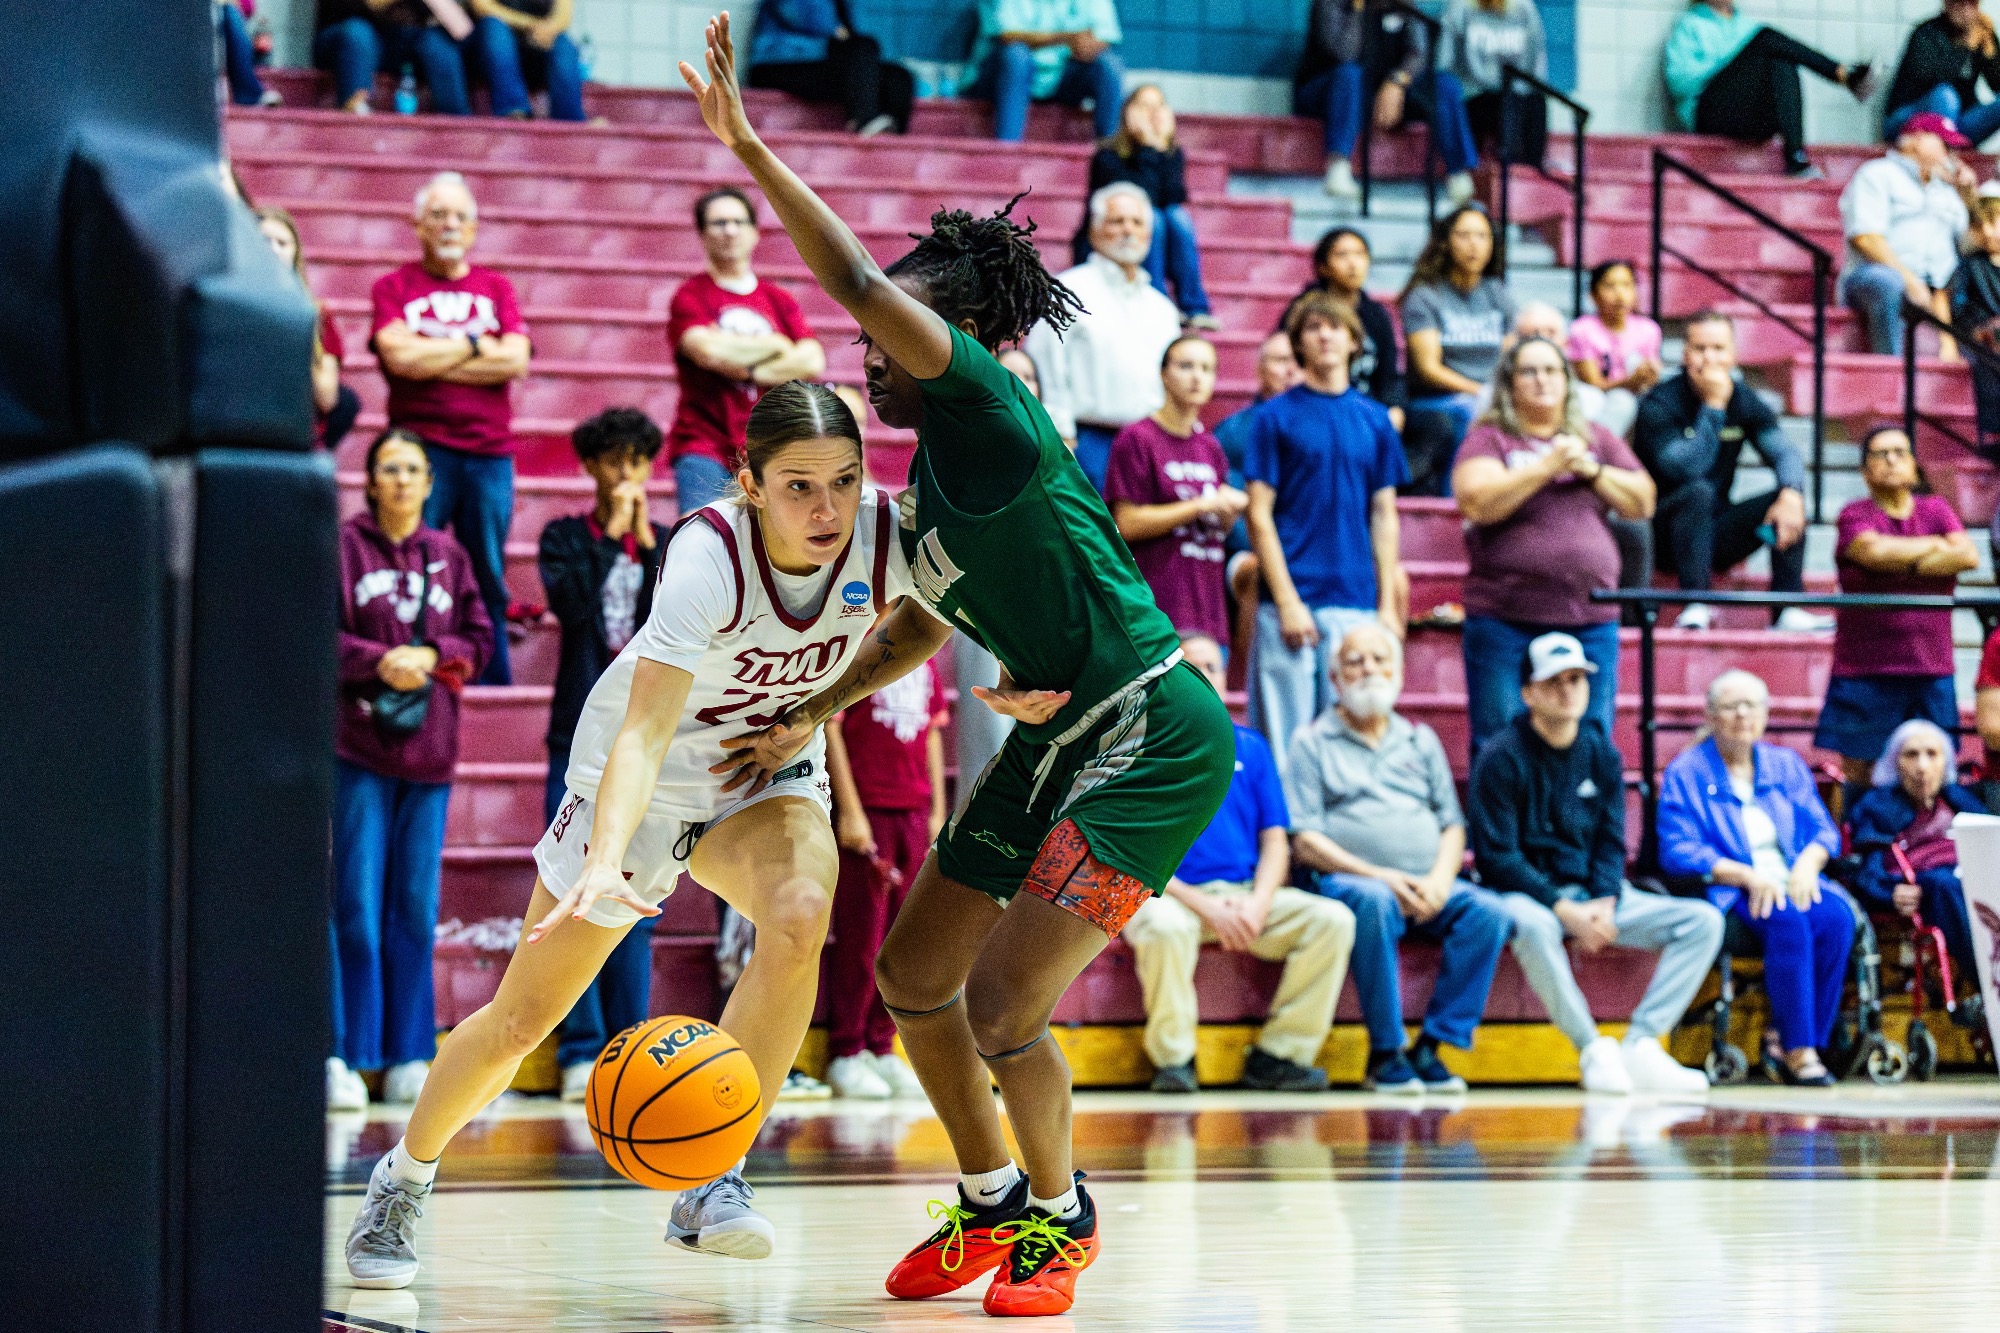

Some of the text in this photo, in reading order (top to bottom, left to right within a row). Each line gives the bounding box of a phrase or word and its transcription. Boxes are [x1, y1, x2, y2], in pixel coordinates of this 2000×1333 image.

[845, 592, 868, 600] NCAA
[731, 634, 849, 687] TWU
[645, 1022, 720, 1068] NCAA
